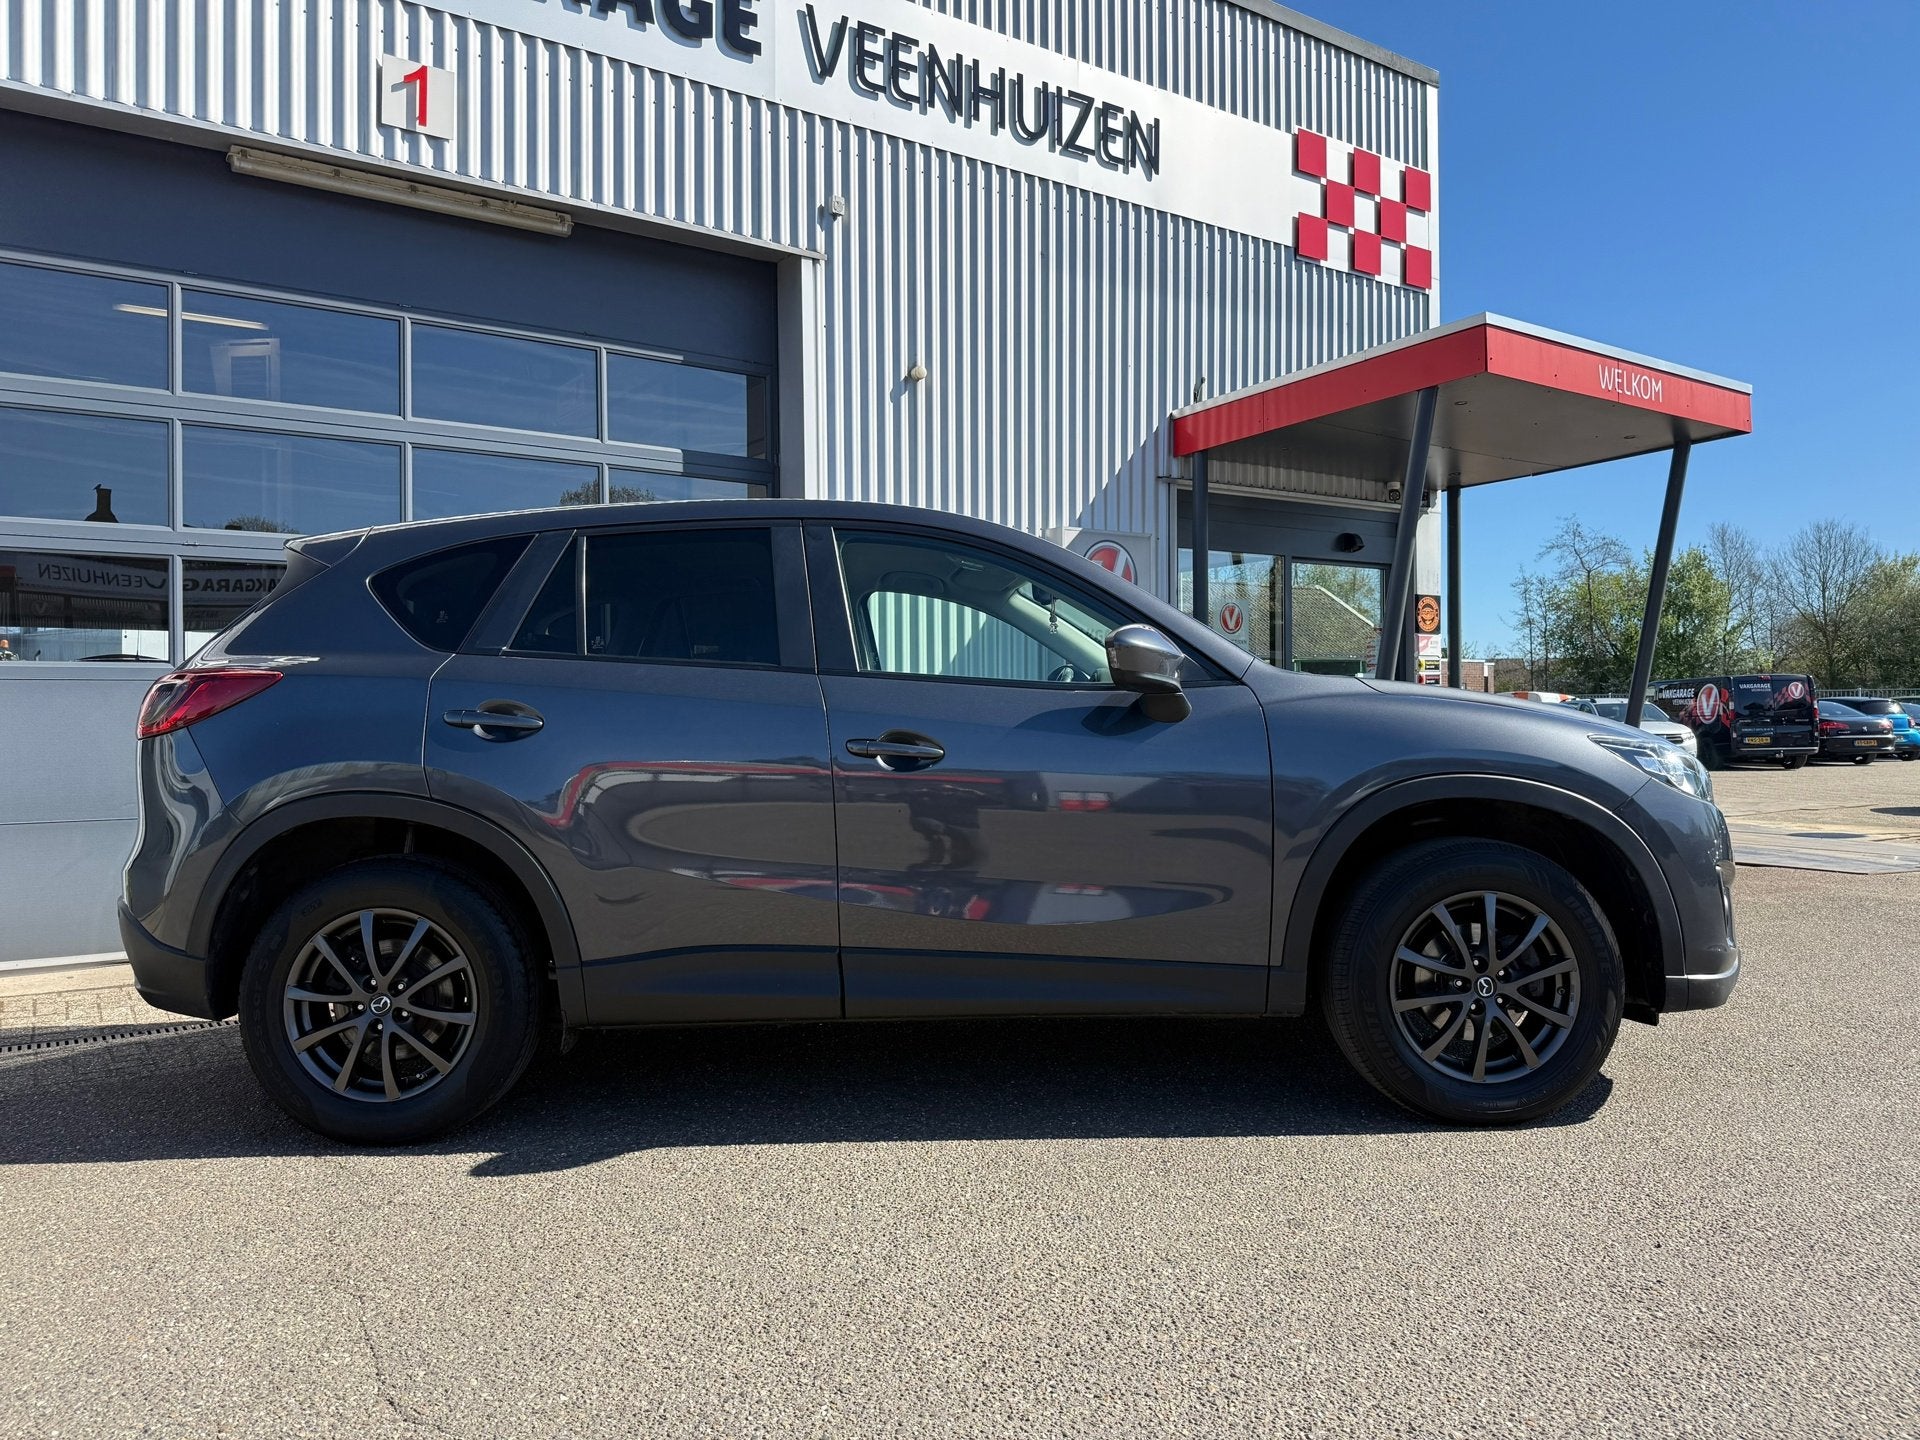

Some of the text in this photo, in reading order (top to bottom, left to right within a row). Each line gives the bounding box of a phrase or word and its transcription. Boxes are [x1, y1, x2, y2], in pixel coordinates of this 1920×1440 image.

[403, 66, 428, 127] 1
[570, 0, 1160, 175] GE VEENHUIZEN
[1599, 364, 1663, 403] WELKOM
[1224, 608, 1239, 630] V
[1701, 687, 1717, 719] V
[1791, 684, 1803, 697] V
